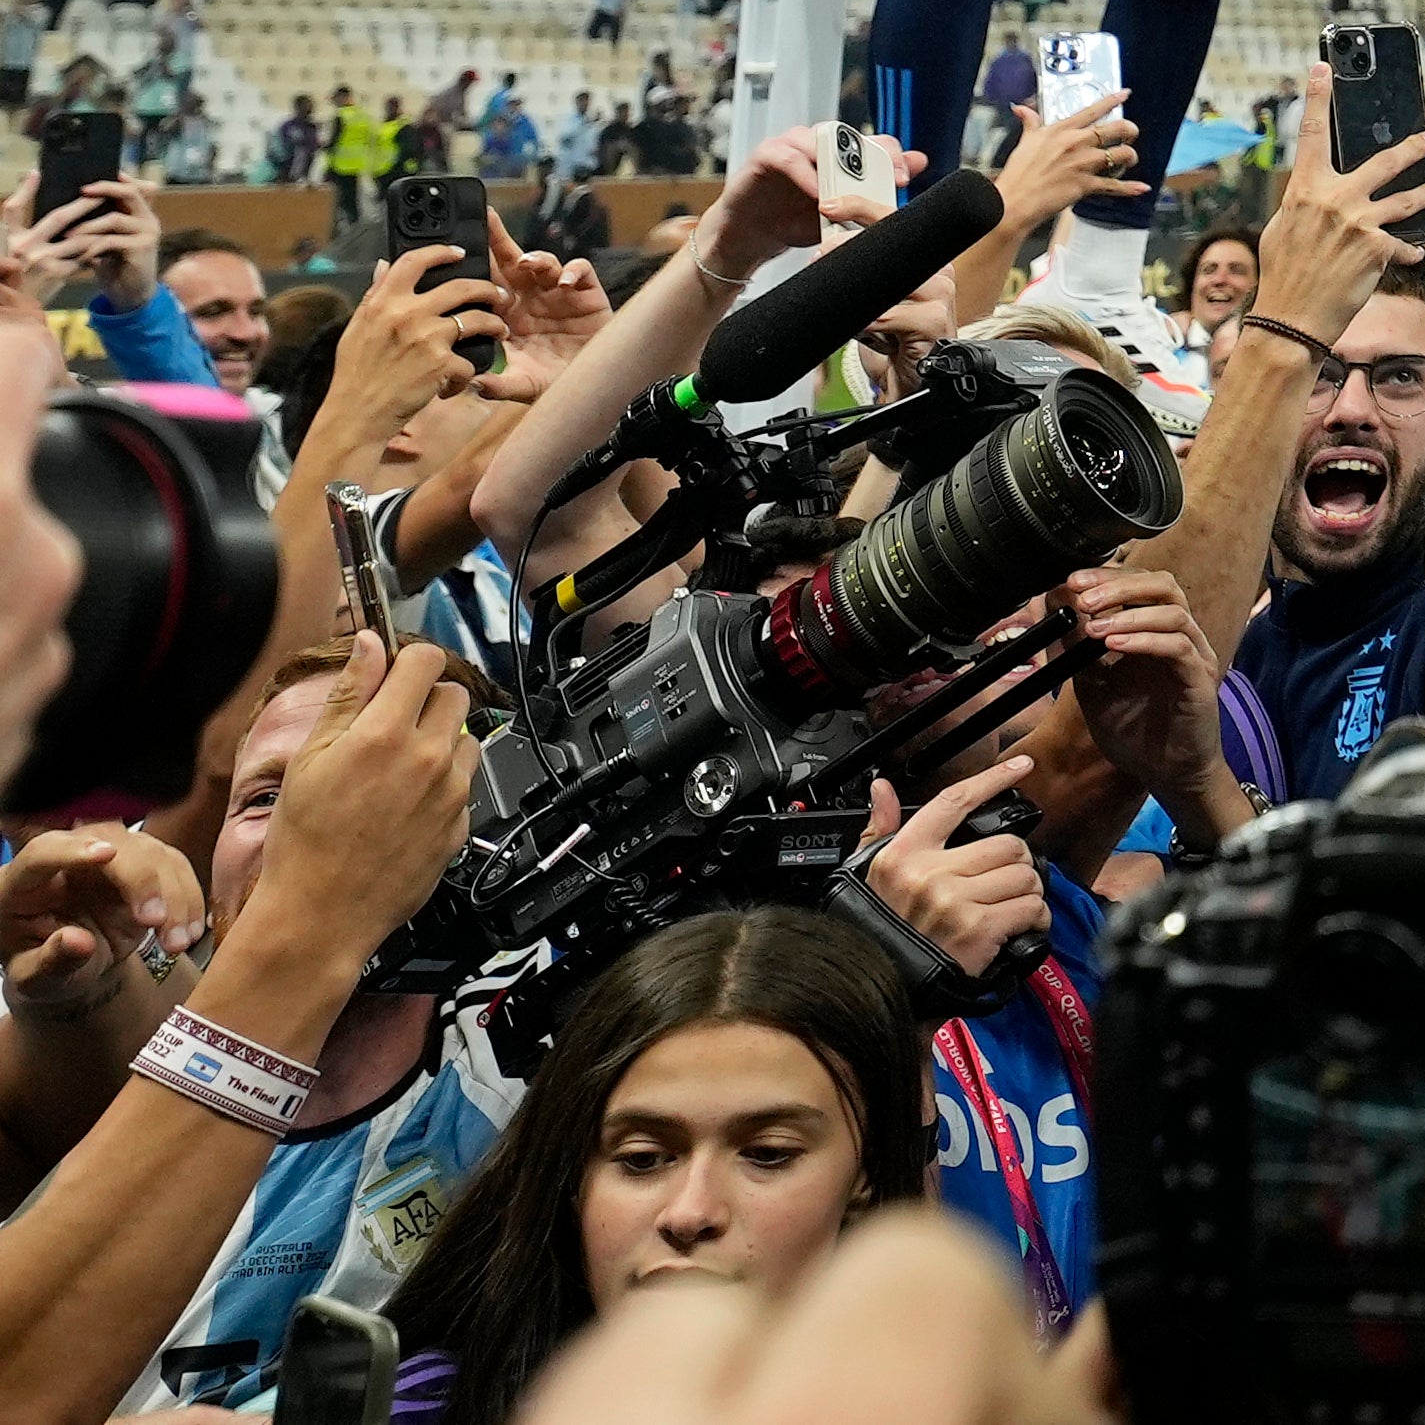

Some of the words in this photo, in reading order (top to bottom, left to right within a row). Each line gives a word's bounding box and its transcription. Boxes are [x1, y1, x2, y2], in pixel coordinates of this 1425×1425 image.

[780, 834, 843, 849] SONY
[1037, 963, 1063, 991] CUP
[163, 1033, 185, 1048] CUP
[227, 1074, 250, 1094] The
[249, 1085, 281, 1106] Final
[388, 1190, 442, 1246] AFA
[256, 1241, 313, 1255] AUSTRALIA
[248, 1253, 304, 1268] DECEMBER
[256, 1265, 275, 1276] BIN
[277, 1263, 297, 1275] ALI
